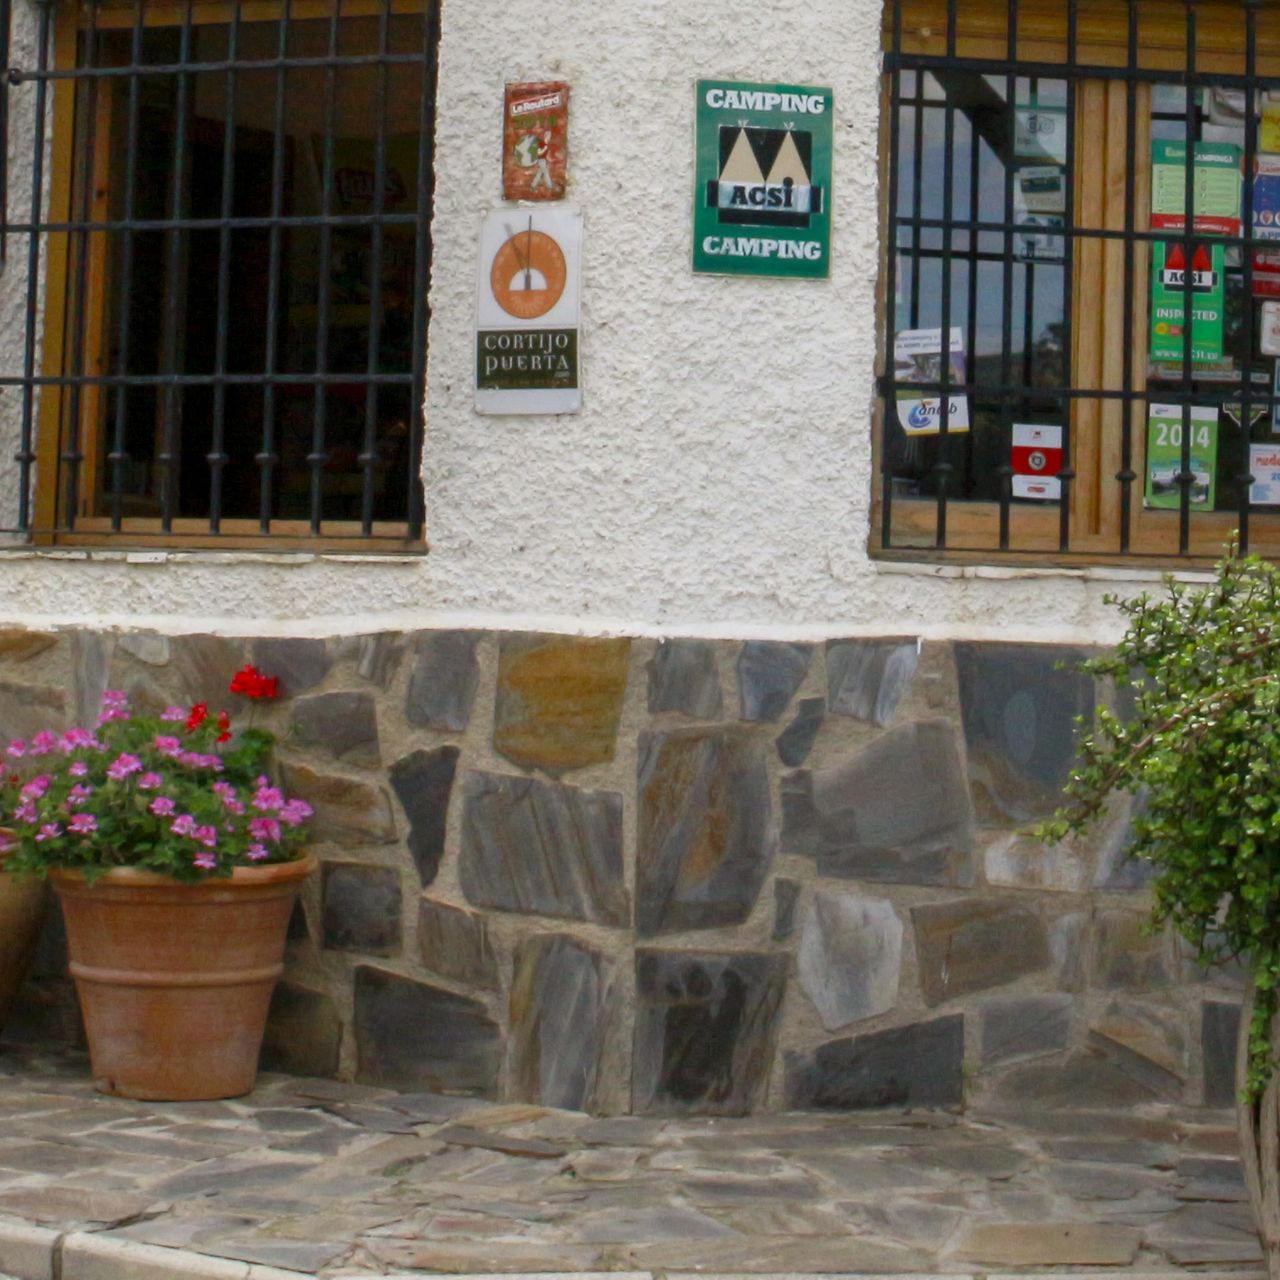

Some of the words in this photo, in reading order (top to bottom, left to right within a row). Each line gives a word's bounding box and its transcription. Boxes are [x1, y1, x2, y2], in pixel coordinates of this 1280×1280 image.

[512, 104, 523, 114] Le
[523, 94, 560, 111] Routard
[705, 88, 825, 115] CAMPING
[729, 176, 794, 208] ACSI
[702, 235, 822, 261] CAMPING
[1156, 308, 1218, 321] INSPTED
[484, 333, 569, 355] CORTIJO
[485, 354, 570, 376] PUERTA
[1156, 422, 1210, 449] 2014
